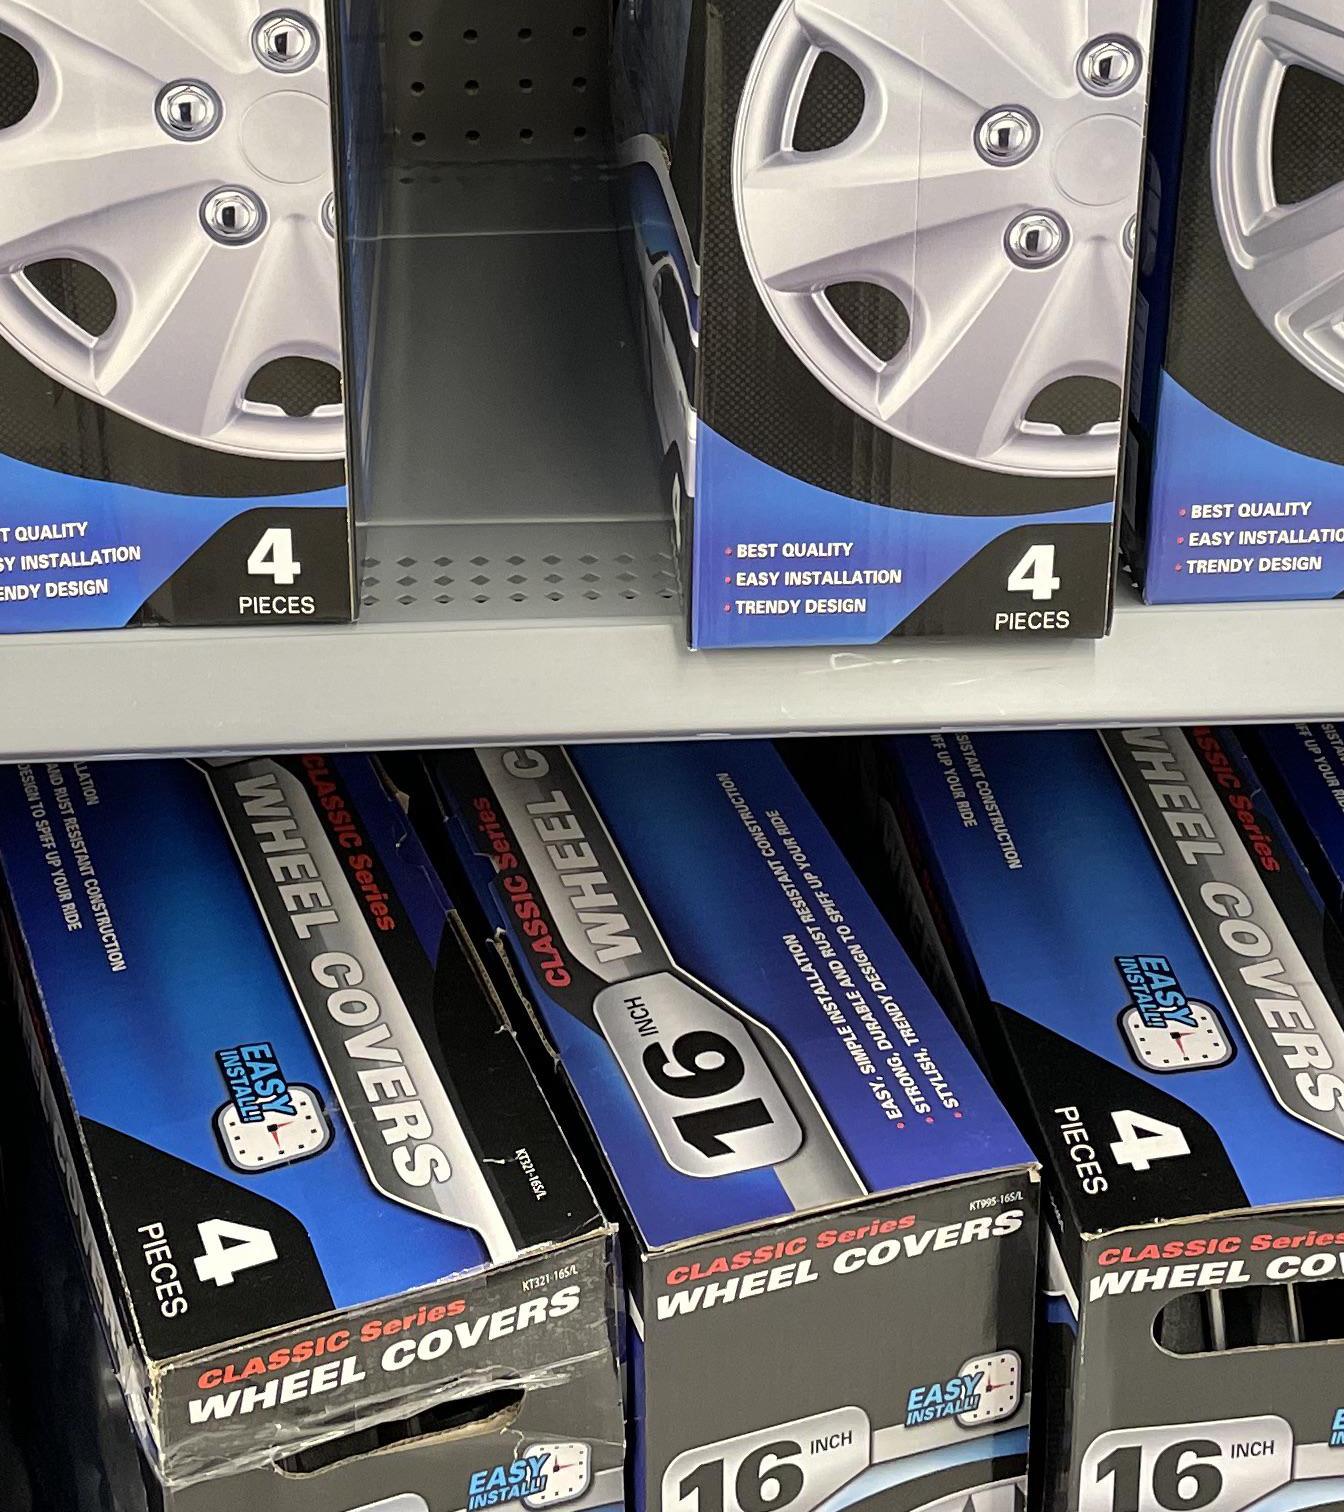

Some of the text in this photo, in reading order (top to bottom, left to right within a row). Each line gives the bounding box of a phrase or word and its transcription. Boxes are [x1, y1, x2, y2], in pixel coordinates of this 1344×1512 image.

[15, 522, 87, 542] QUALITY
[20, 546, 141, 570] INSTALLATION
[247, 528, 301, 584] 4
[45, 579, 108, 598] DESIGN
[238, 596, 315, 614] PIECES
[716, 772, 775, 857] CONSTRUCTION
[766, 809, 790, 837] RIDE
[784, 837, 810, 870] YOUR
[767, 860, 815, 923] RESISTANT
[804, 872, 823, 889] UP
[816, 891, 843, 923] SPIFF
[806, 926, 836, 958] RUST
[836, 925, 854, 943] TO
[783, 934, 845, 1027] INSTALLATION
[828, 961, 854, 987] AND
[848, 944, 887, 991] DESIGN
[847, 990, 893, 1050] DURABLE
[878, 996, 919, 1047] TRENDY
[836, 1026, 876, 1075] SIMPLE
[623, 996, 773, 1160] 16 INCH
[1097, 1237, 1251, 1266] CLASSIC
[1089, 1261, 1251, 1301] WHEEL
[188, 1286, 581, 1423] WHEEL COVERS
[198, 1299, 467, 1388] CLASSIC Series
